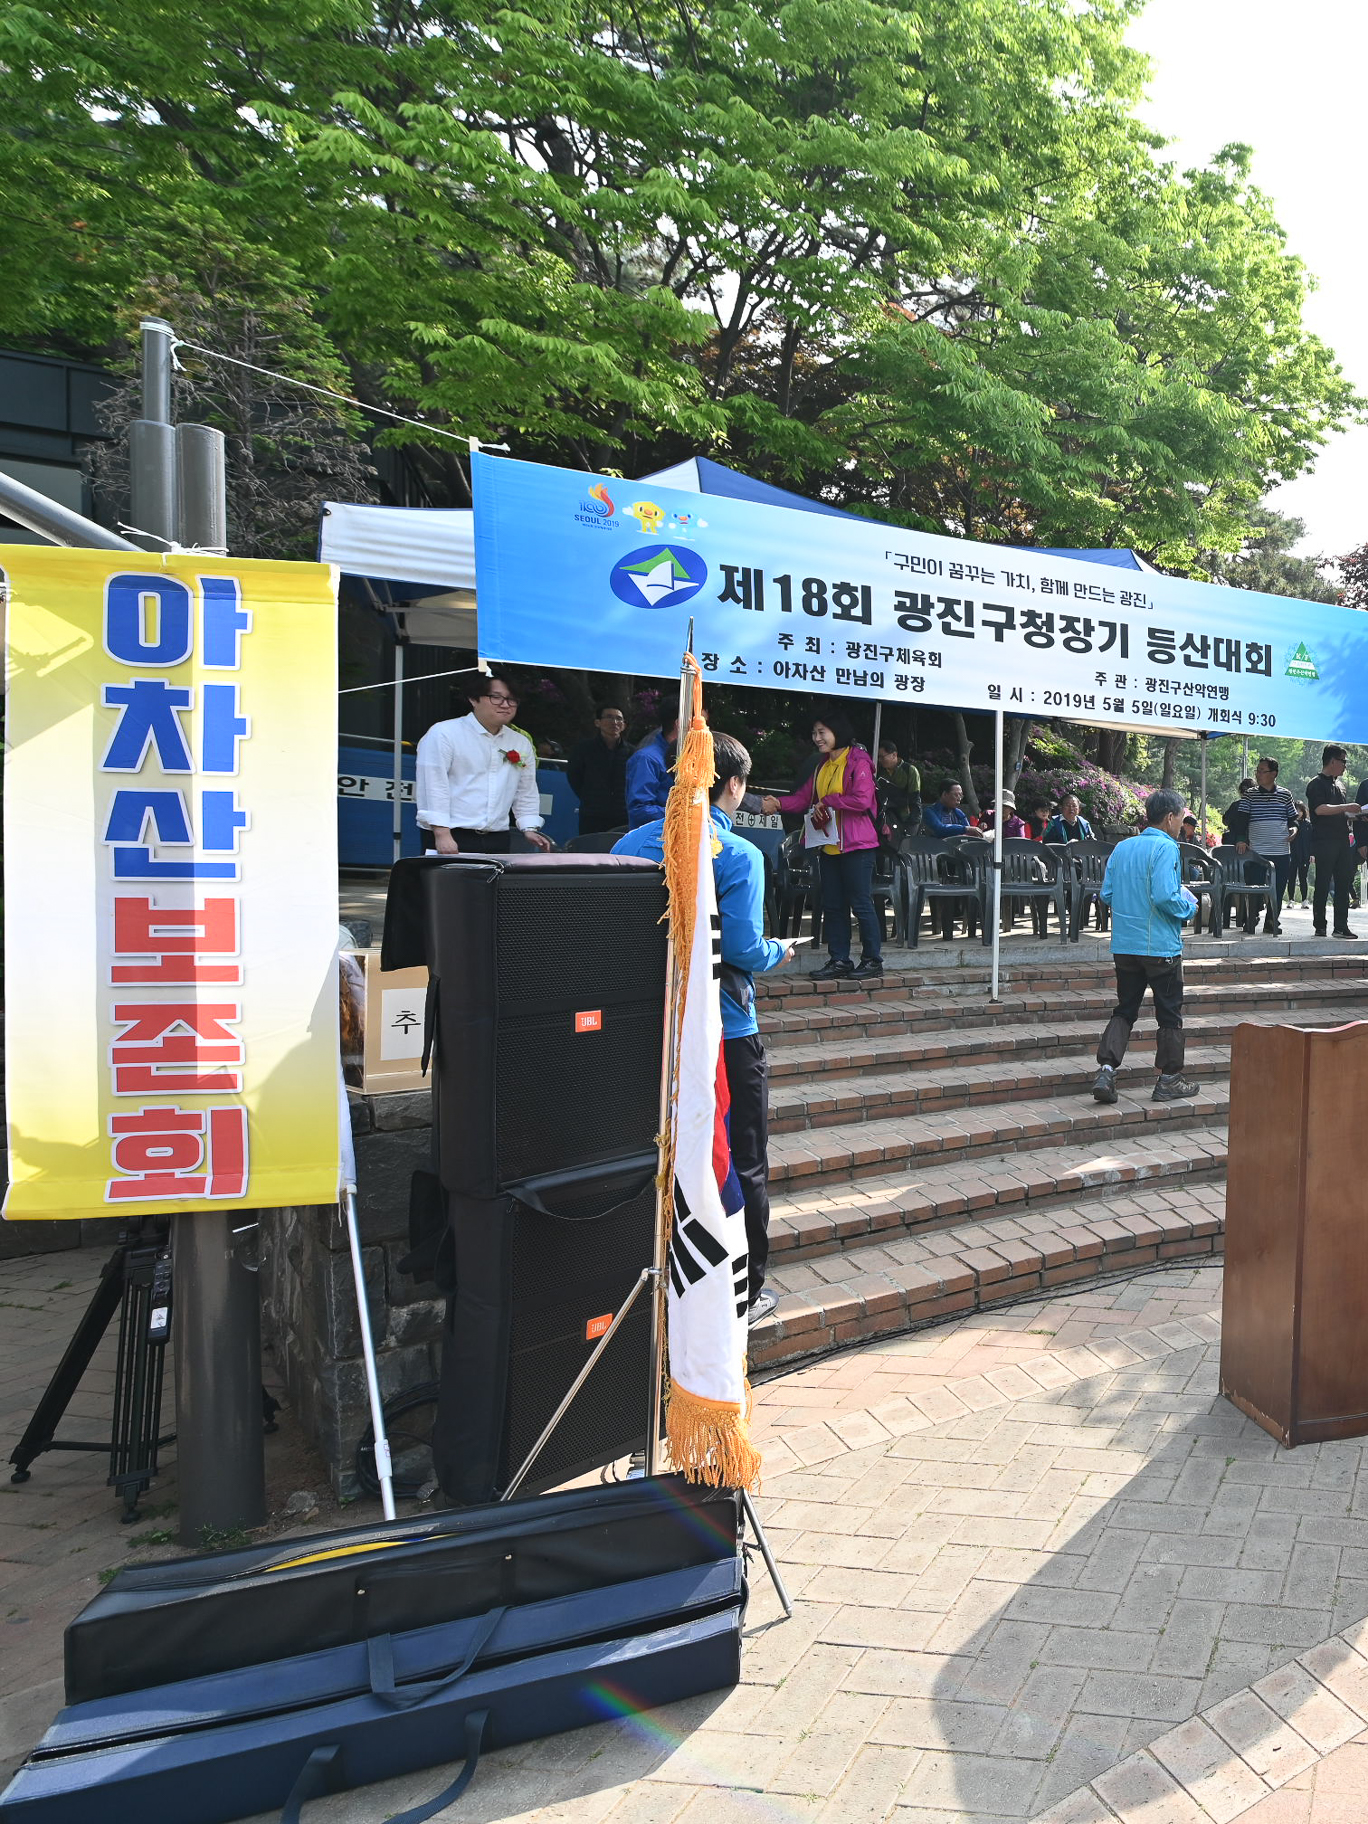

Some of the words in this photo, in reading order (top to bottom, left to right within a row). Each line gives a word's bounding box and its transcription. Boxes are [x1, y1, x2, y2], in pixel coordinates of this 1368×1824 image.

[574, 514, 601, 525] SEOUL
[603, 519, 620, 528] 2019
[949, 562, 996, 585] 꿈꾸는
[1000, 570, 1036, 593] 가치,
[1040, 577, 1069, 597] 함께
[1073, 583, 1116, 605] 만드는
[717, 564, 872, 625] 제18회
[893, 589, 1129, 659] 광진구청장기
[1147, 626, 1272, 677] 등산대회
[845, 641, 942, 668] 광진구체육회
[835, 667, 884, 688] 만남의
[894, 673, 925, 692] 광장
[1145, 677, 1230, 700] 광진구산악연맹
[1043, 690, 1096, 710] 2019년
[1102, 697, 1125, 713] 5월
[1131, 699, 1201, 720] 5일(일요일)
[1208, 707, 1242, 724] 개회식
[1248, 712, 1277, 727] 9:30
[390, 1010, 422, 1035] 추
[581, 1016, 598, 1027] JBL
[591, 1321, 607, 1333] JBL
